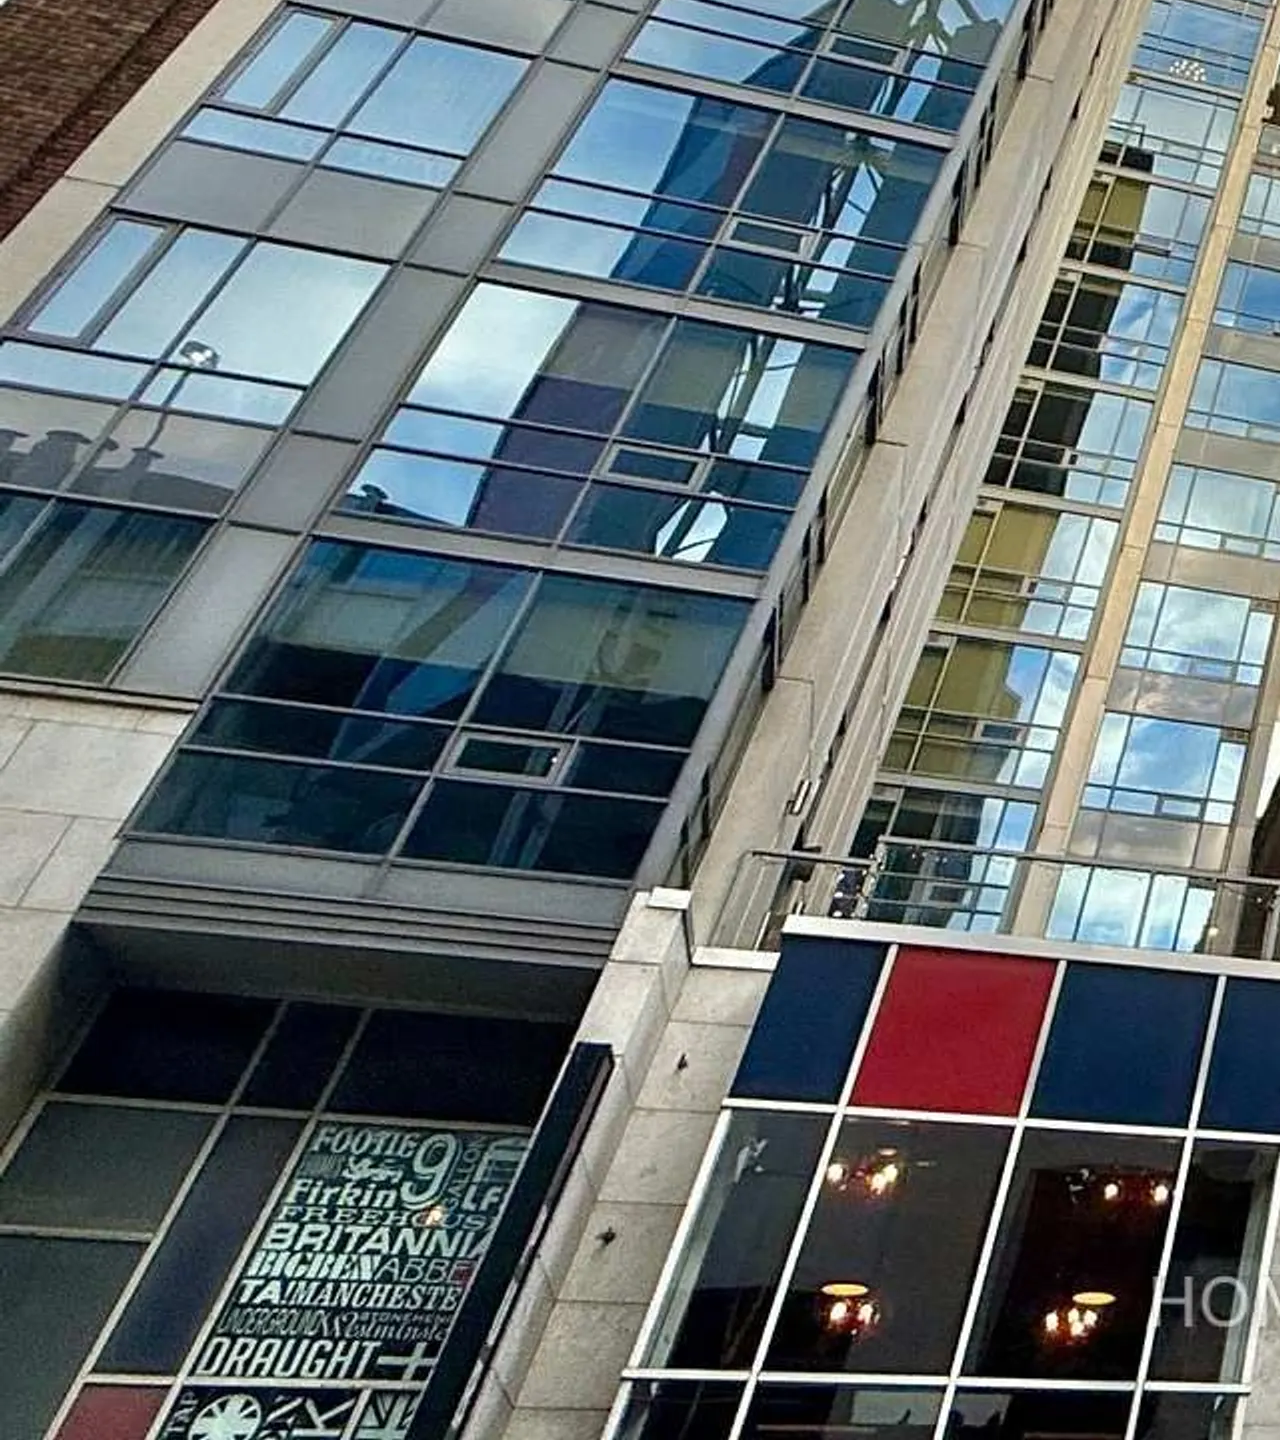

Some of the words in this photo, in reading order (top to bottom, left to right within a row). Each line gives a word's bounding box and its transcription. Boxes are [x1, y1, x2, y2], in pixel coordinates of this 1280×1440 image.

[311, 1126, 421, 1158] FOOTIE
[400, 1133, 460, 1210] 9
[282, 1178, 399, 1208] Firkin
[201, 1336, 383, 1378] DRAUGHT
